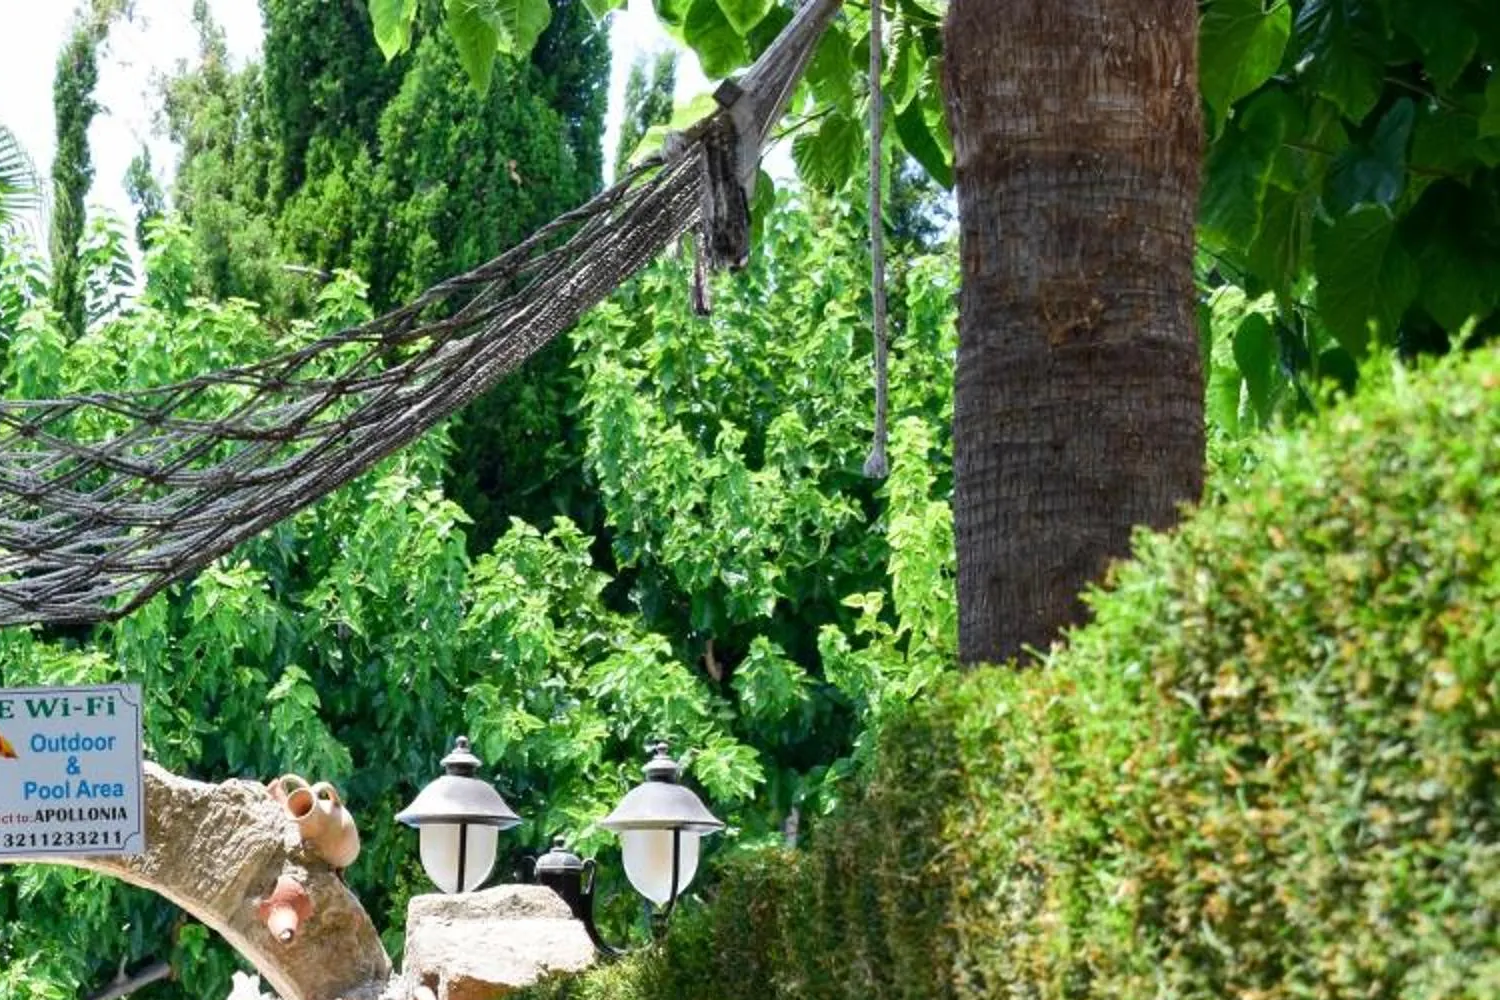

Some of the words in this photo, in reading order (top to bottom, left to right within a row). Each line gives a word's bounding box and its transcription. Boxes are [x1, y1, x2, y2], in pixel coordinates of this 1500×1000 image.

[25, 696, 116, 719] Wi-Fi
[30, 732, 117, 753] Outdoor
[66, 756, 81, 776] &
[24, 781, 70, 800] Pool
[76, 779, 125, 799] Area
[34, 806, 128, 823] APOLLONIA
[3, 830, 122, 848] 3211233211
